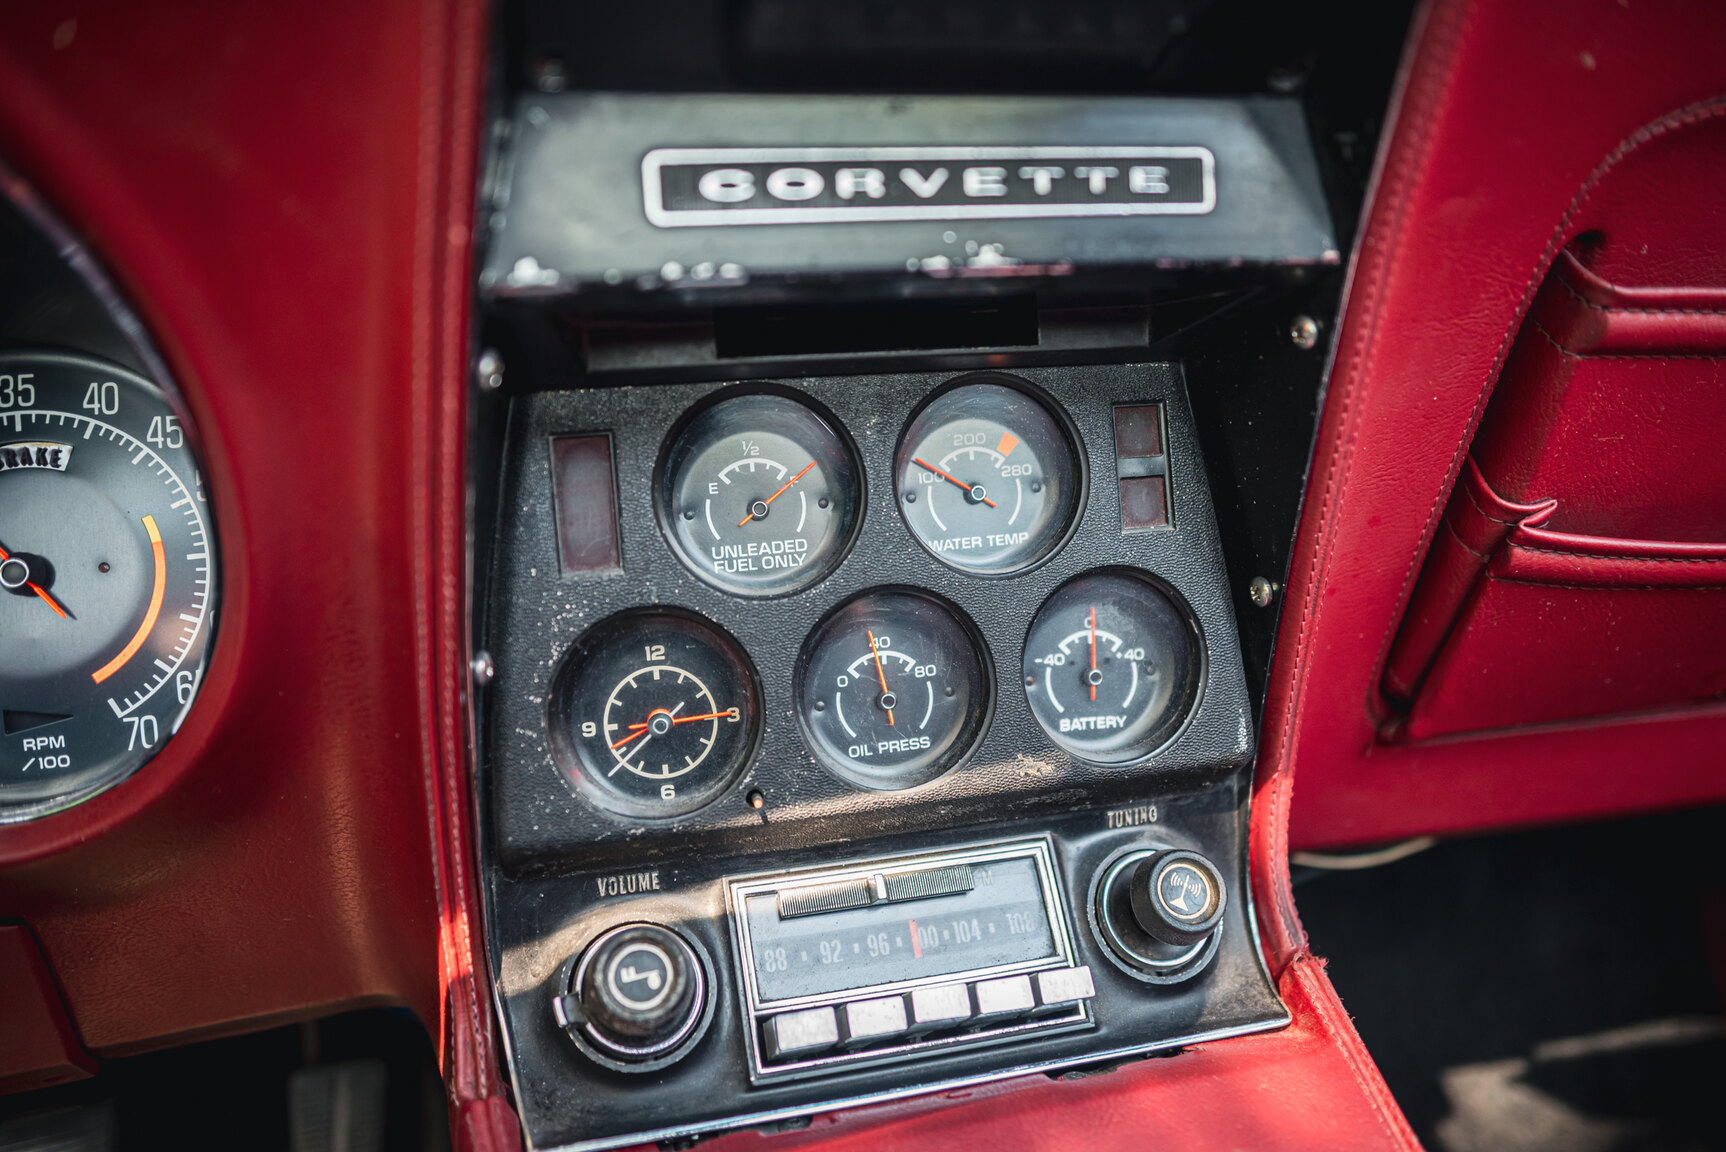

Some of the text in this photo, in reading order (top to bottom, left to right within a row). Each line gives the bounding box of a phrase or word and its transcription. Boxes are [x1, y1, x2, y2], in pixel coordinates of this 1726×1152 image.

[698, 166, 1170, 202] CORVETTE
[0, 374, 35, 408] 35
[83, 382, 118, 415] 40
[147, 415, 184, 448] 45
[953, 433, 986, 446] 200
[0, 446, 62, 469] RAKE
[918, 472, 945, 484] 100
[1001, 463, 1032, 477] 280
[708, 482, 719, 494] E
[712, 538, 808, 559] UNLEADED
[928, 532, 1029, 552] WATER TEMP
[713, 553, 807, 574] FUEL ONLY
[869, 636, 891, 649] 40
[645, 645, 665, 661] 12
[837, 675, 848, 688] 0
[914, 665, 936, 678] 80
[176, 670, 200, 704] 6
[726, 706, 740, 722] 3
[1059, 715, 1127, 732] BATTERY
[122, 715, 159, 751] 70
[581, 721, 596, 738] 9
[23, 735, 65, 751] RPM
[848, 736, 931, 758] OIL PRESS
[660, 784, 675, 800] 6
[1106, 805, 1158, 829] TUNING
[596, 871, 660, 897] VOLUME
[764, 947, 788, 973] 88
[820, 939, 844, 964] 92
[867, 932, 890, 957] 96
[914, 924, 939, 950] 00
[952, 918, 982, 943] 104
